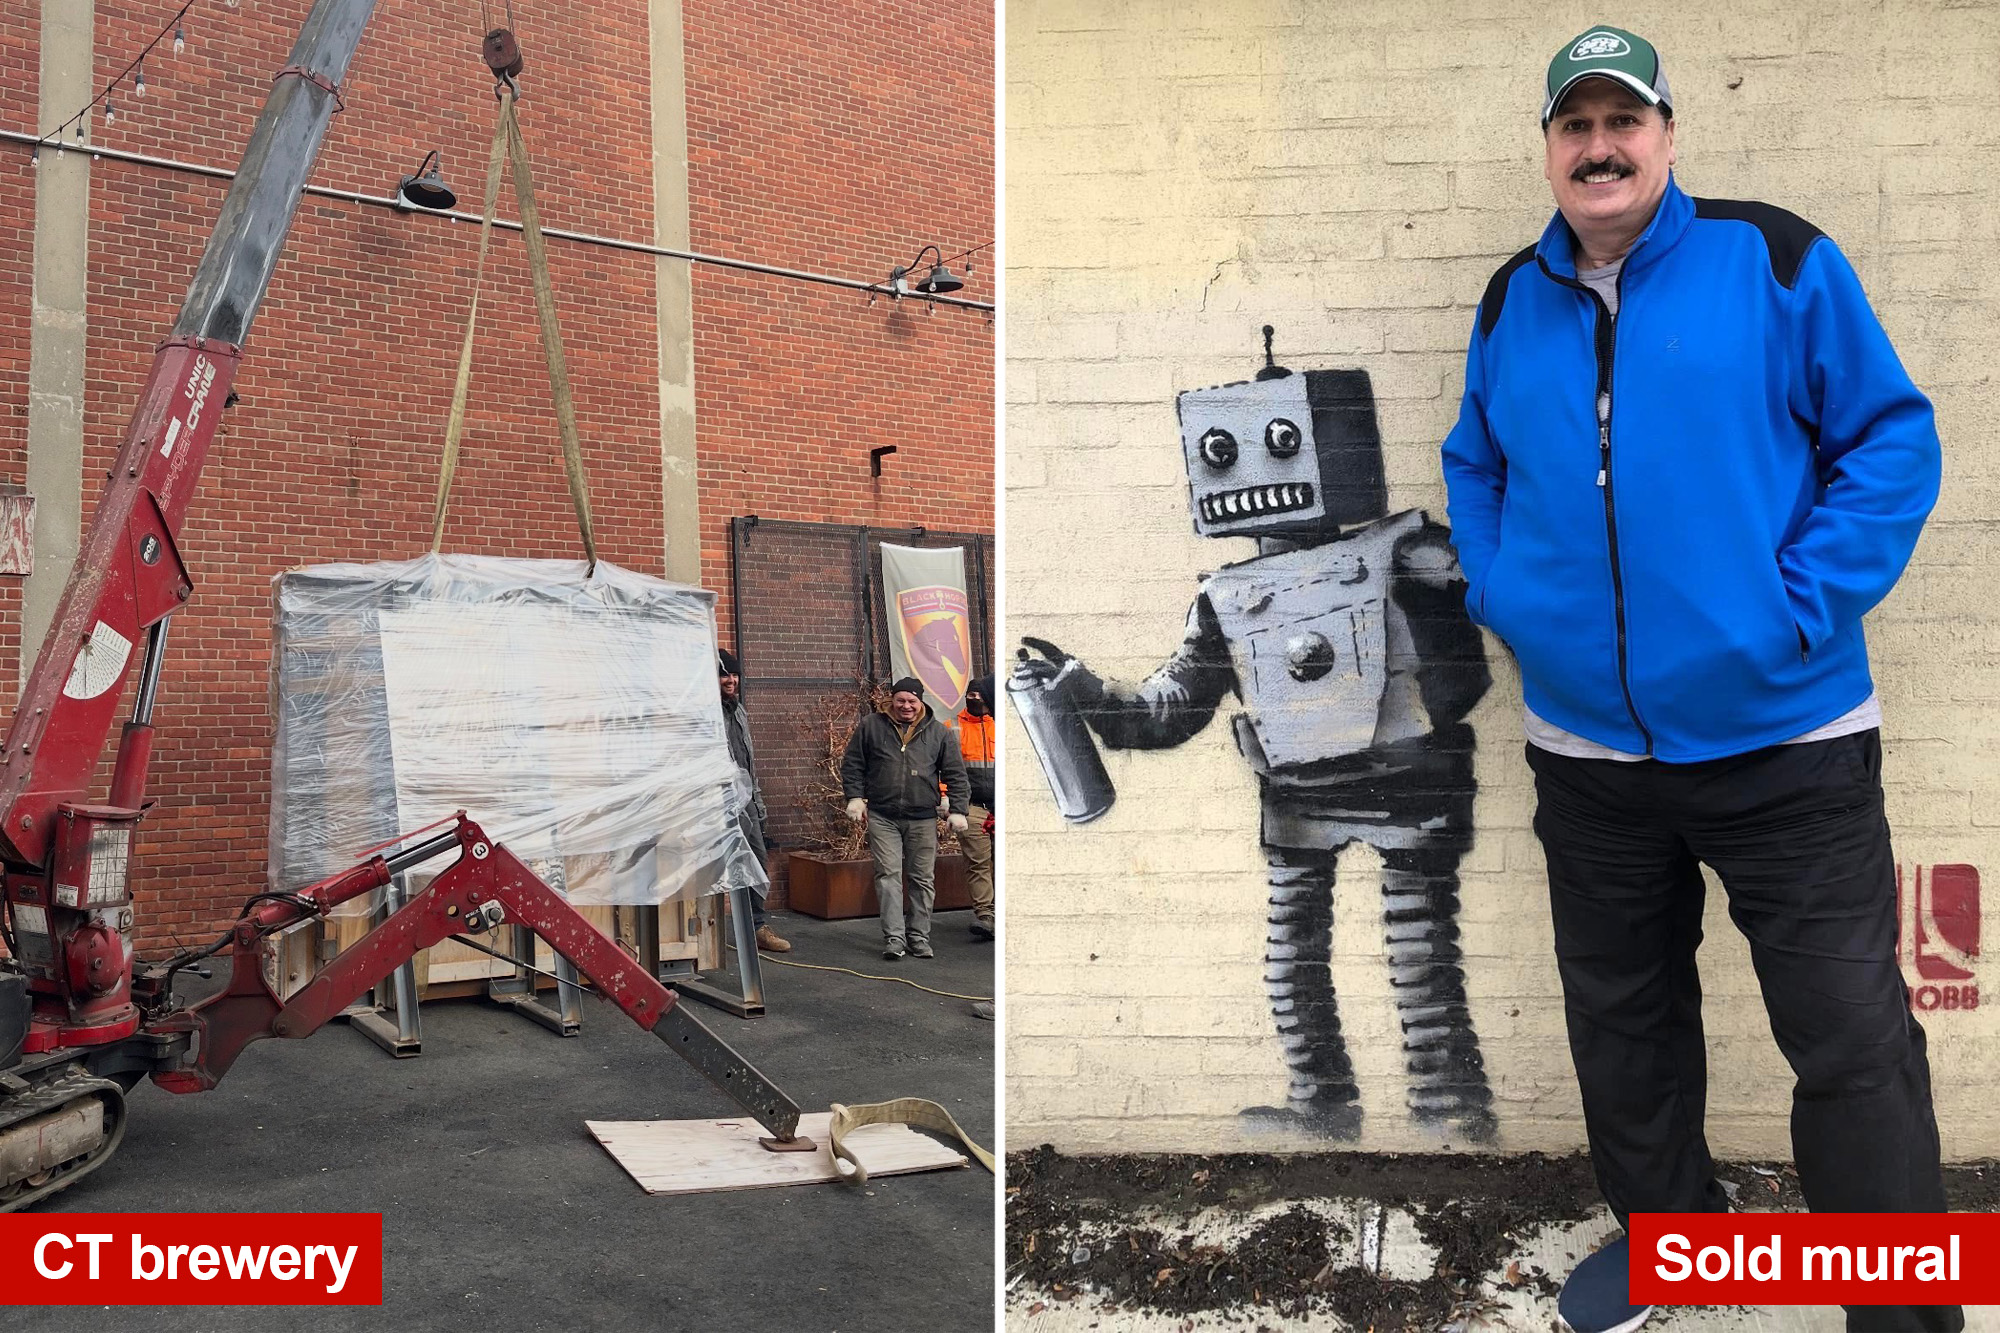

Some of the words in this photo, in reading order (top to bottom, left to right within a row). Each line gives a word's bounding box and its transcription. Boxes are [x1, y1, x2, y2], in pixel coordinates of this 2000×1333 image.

[185, 354, 206, 399] UNIC
[902, 592, 936, 606] BLACK
[474, 844, 487, 857] 3
